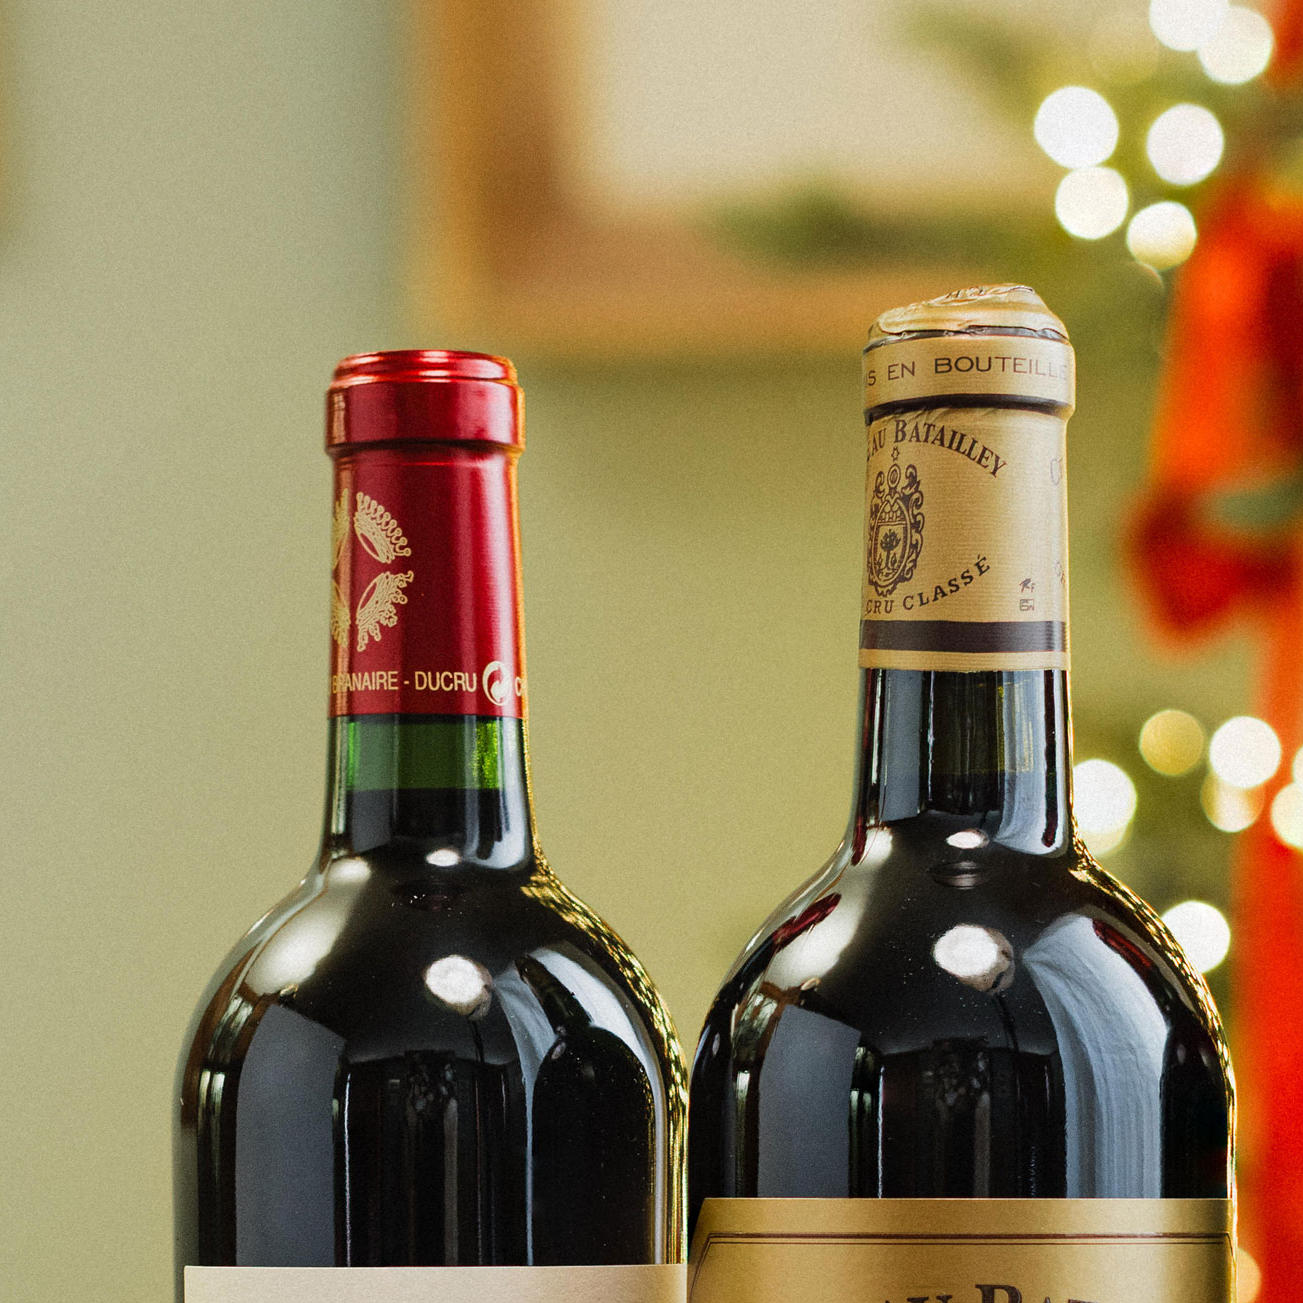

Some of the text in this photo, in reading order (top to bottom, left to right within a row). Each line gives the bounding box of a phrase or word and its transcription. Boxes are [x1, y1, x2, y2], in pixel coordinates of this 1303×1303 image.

[888, 361, 916, 381] EN
[894, 419, 1007, 477] BATAILLEY
[903, 554, 990, 610] CLASSÉ
[415, 671, 477, 692] DUCRU
